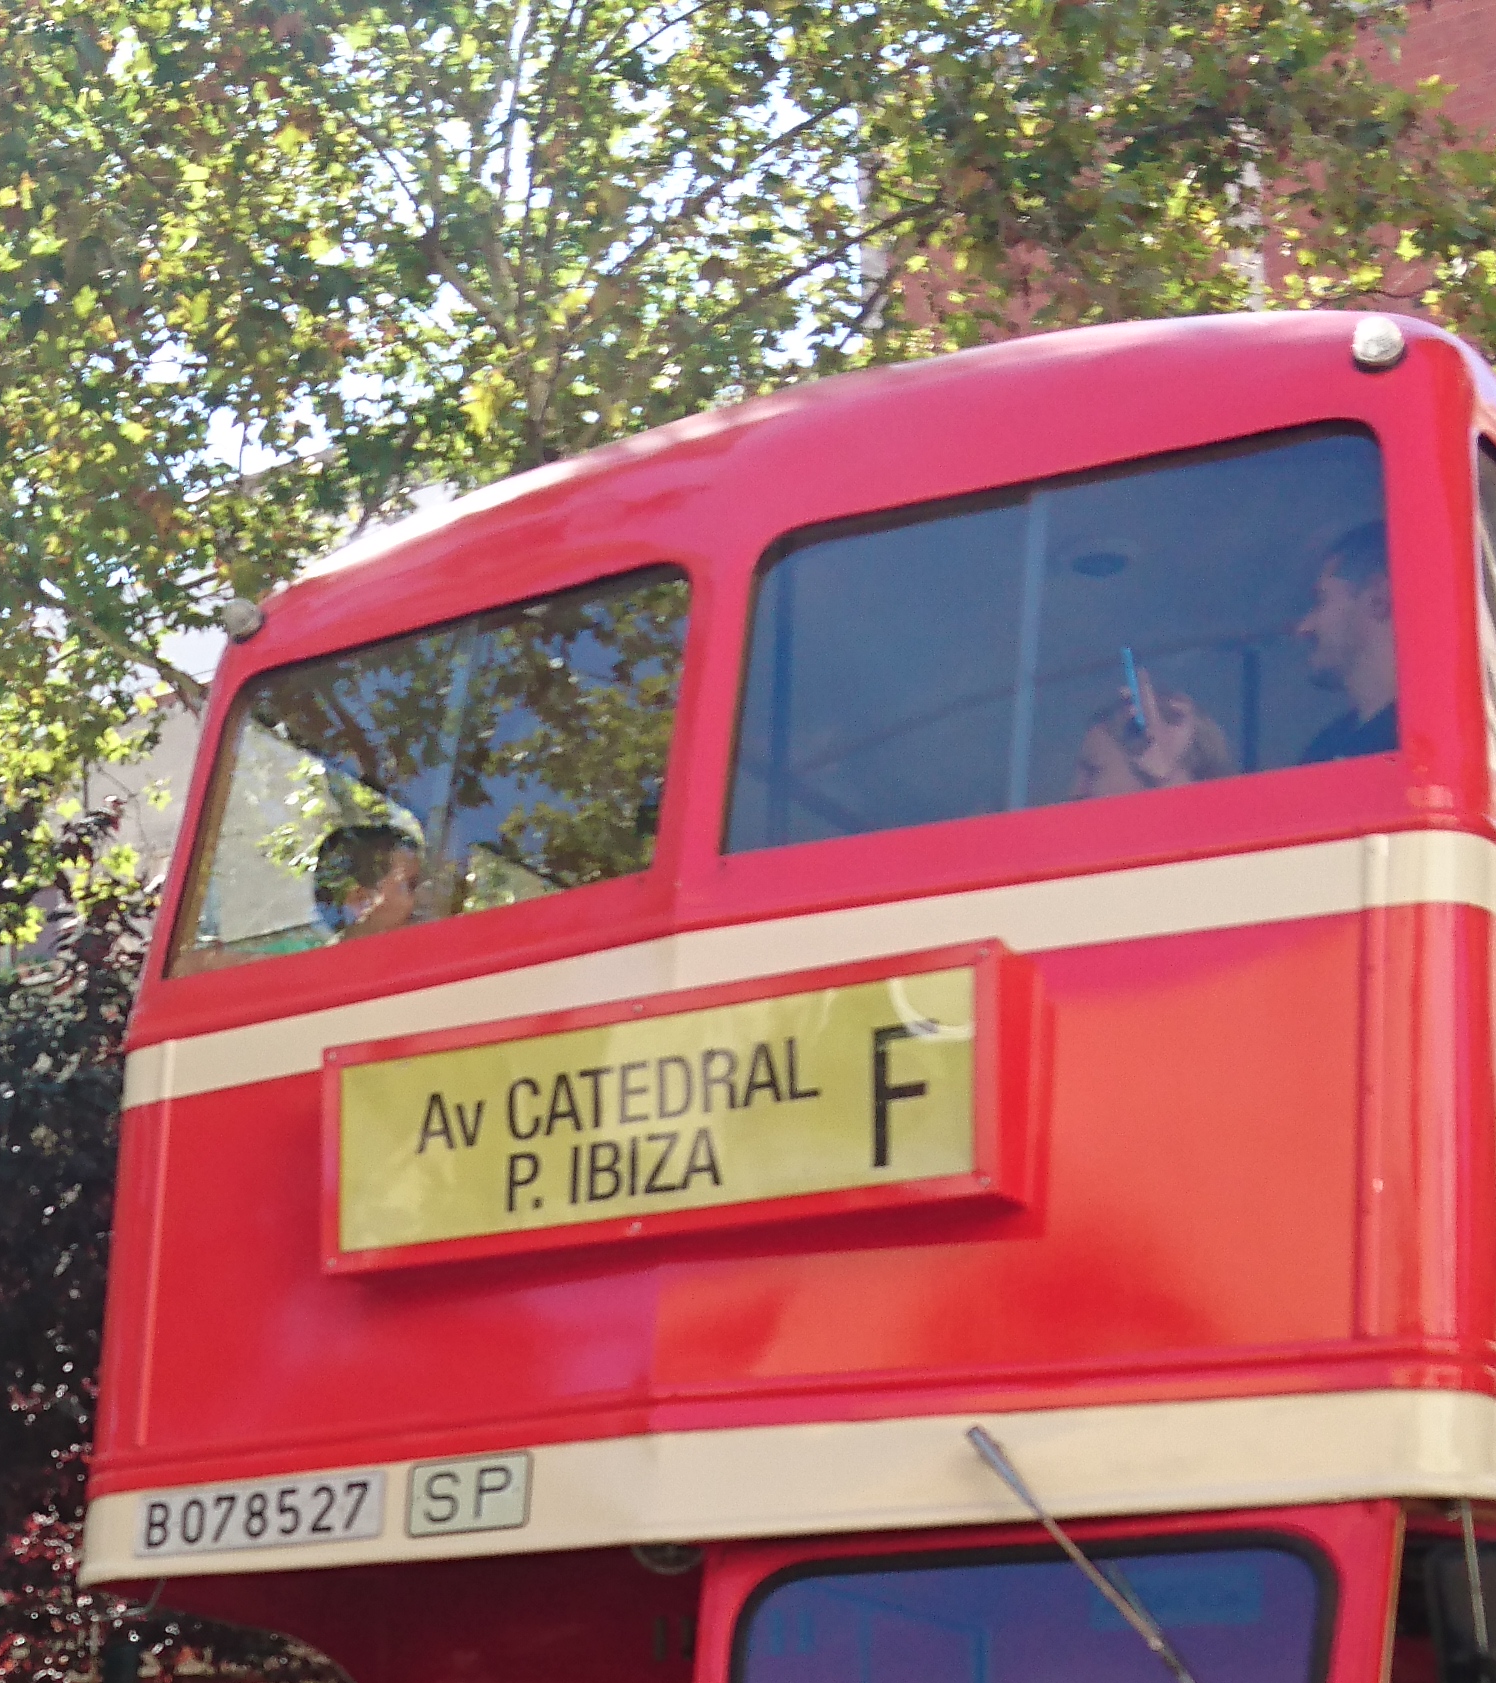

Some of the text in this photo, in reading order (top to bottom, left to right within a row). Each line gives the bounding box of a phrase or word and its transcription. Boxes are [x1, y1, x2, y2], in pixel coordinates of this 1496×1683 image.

[417, 1036, 821, 1154] Av CATEDRAL
[872, 1019, 939, 1168] F
[505, 1127, 722, 1212] P. IBIZA
